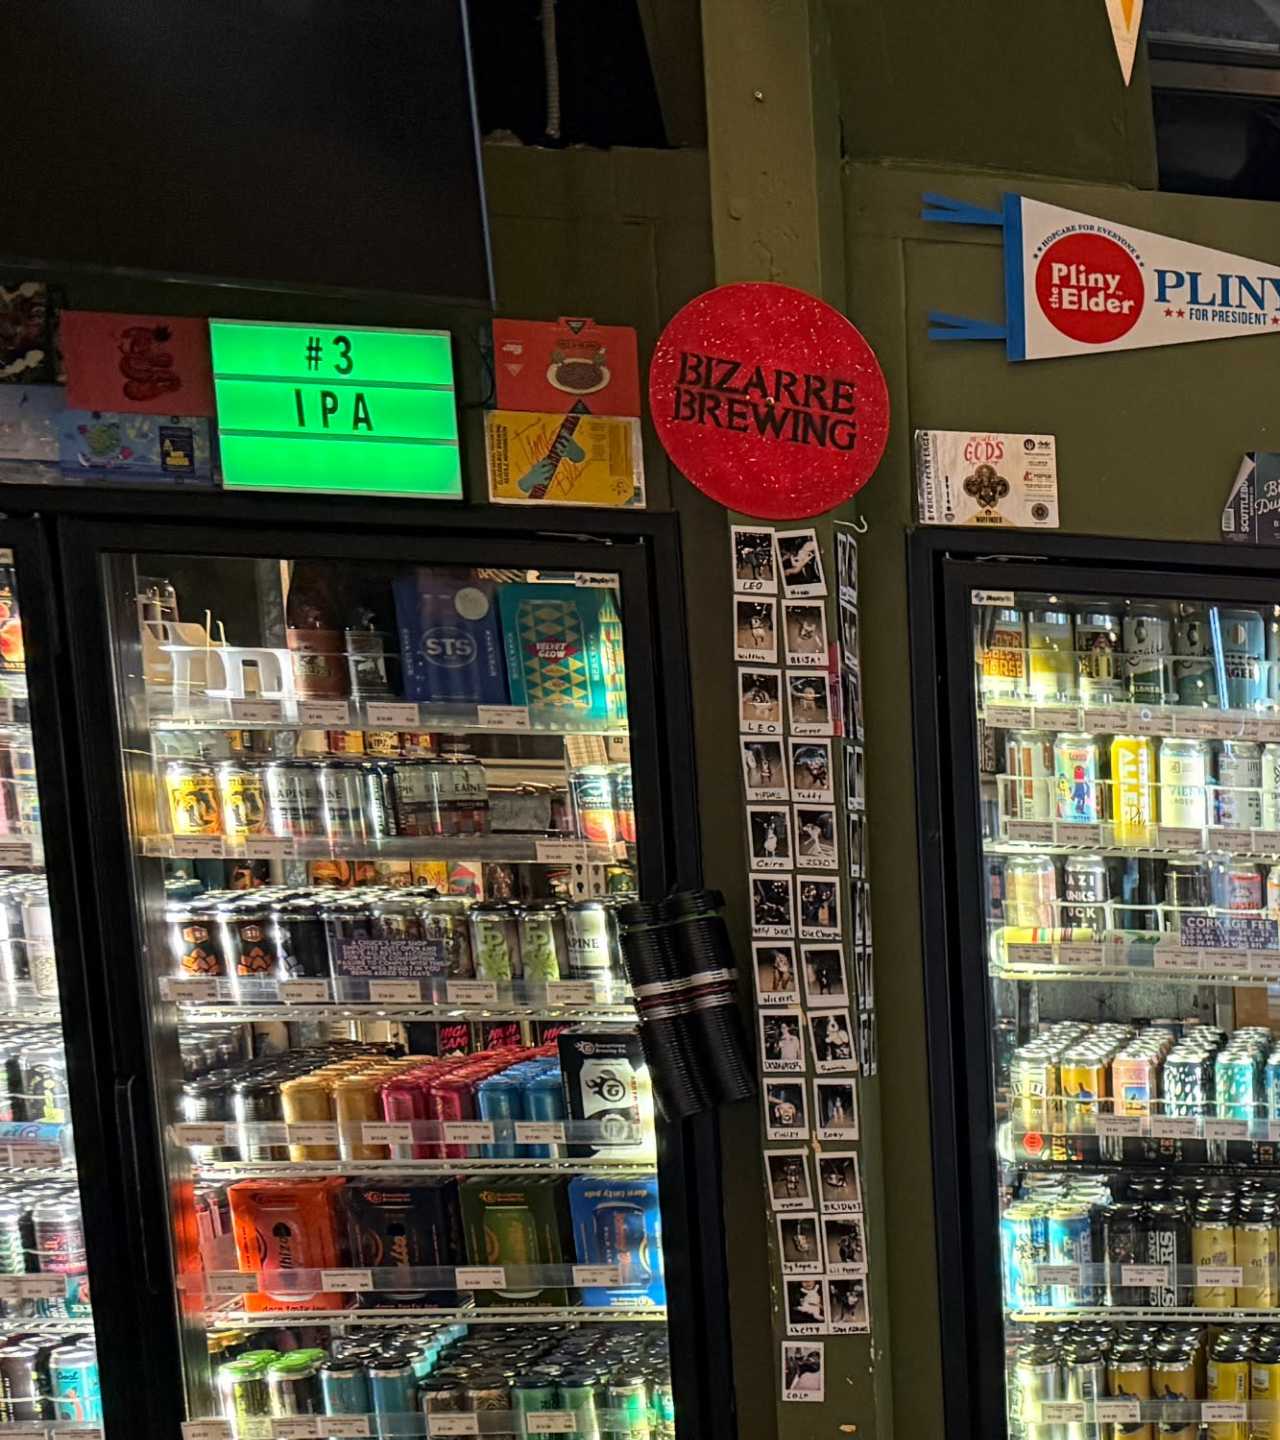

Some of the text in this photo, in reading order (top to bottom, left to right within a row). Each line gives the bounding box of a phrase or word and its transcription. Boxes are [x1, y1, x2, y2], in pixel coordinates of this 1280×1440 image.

[1042, 225, 1077, 247] HOPCARE
[1097, 225, 1136, 254] EVERYONE
[1051, 263, 1121, 294] Pliny
[1049, 287, 1135, 314] the Elder
[1189, 307, 1267, 326] FOR PRESIDENT
[305, 335, 354, 376] #3
[677, 351, 856, 415] BIZARRE
[294, 387, 374, 431] IPA
[674, 386, 858, 451] BREWING
[743, 582, 762, 590] LEO
[426, 638, 473, 656] STS
[538, 650, 566, 658] GLOW
[748, 723, 775, 733] LEO
